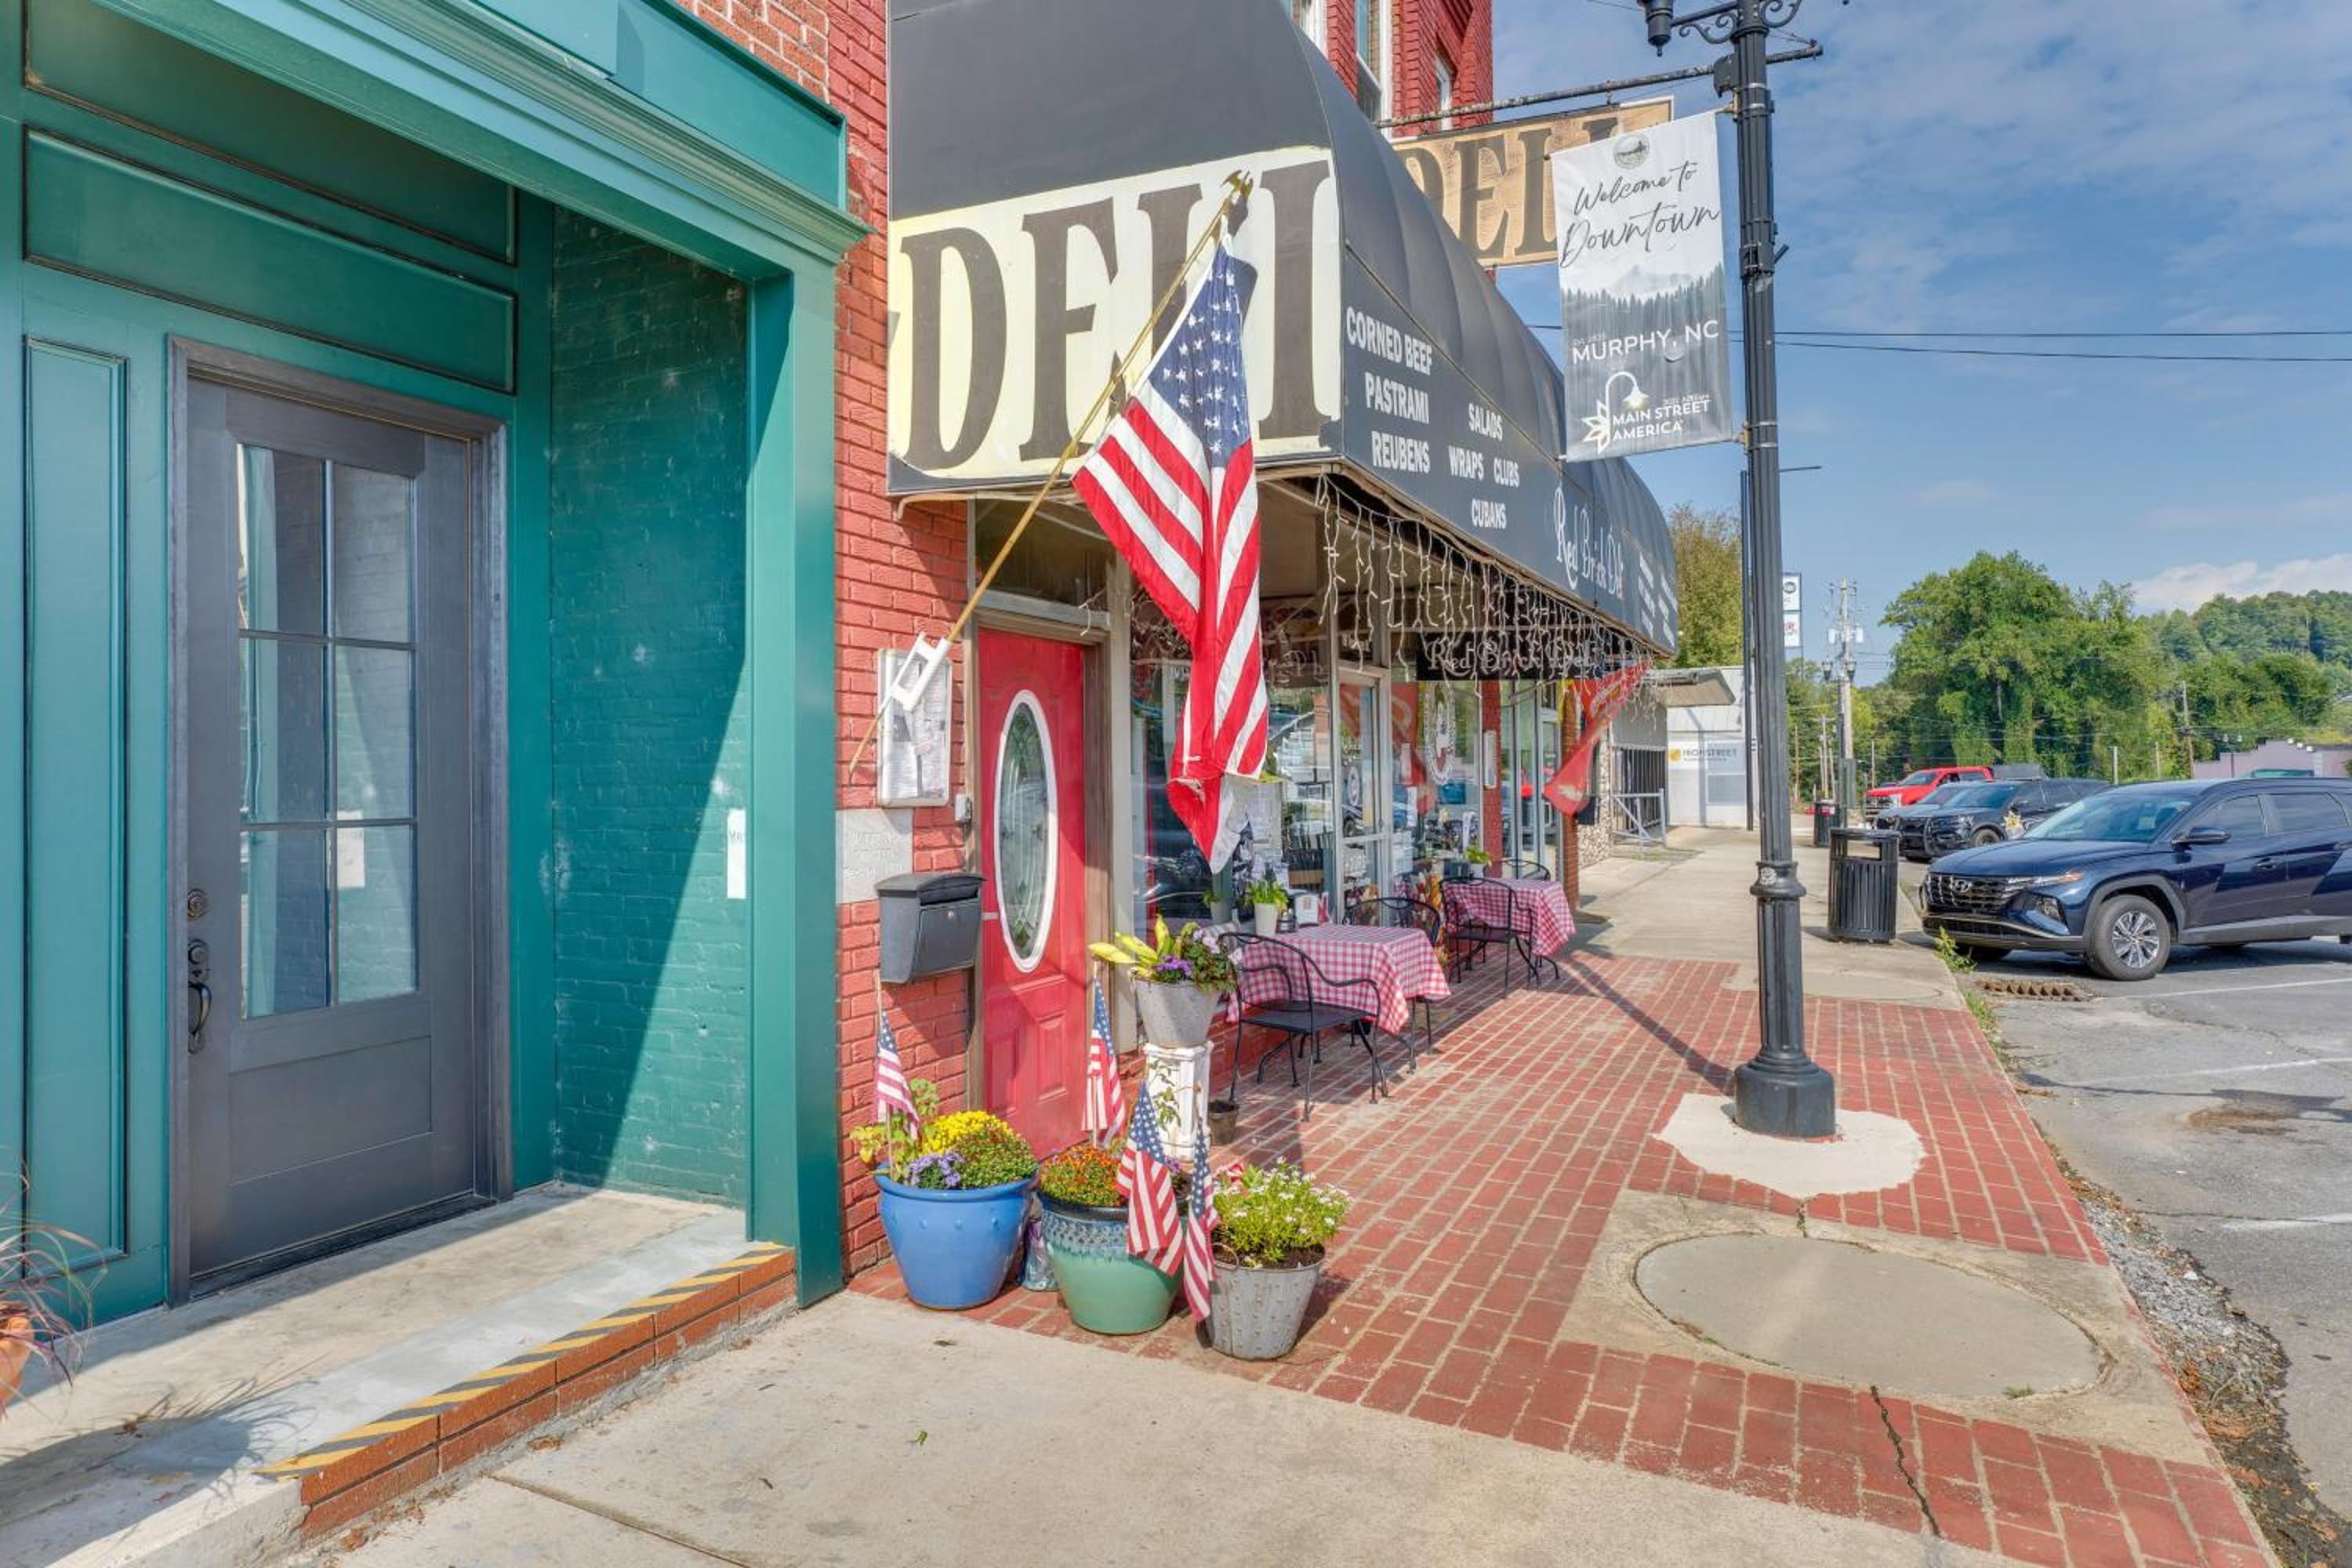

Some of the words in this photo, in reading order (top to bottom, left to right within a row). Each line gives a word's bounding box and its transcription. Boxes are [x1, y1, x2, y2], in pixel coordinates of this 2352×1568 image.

[1393, 118, 1617, 260] EL
[1573, 176, 1671, 216] Welcome
[1669, 160, 1697, 191] to
[1560, 201, 1720, 268] Downtown
[1346, 307, 1401, 364] CORNED
[1404, 334, 1433, 376] BEEF
[1572, 328, 1677, 365] MURPHY,
[1685, 320, 1719, 343] NC
[1364, 372, 1430, 424] PASTRAMI
[1613, 408, 1651, 426] MAIN
[1655, 399, 1711, 419] STREET
[1468, 403, 1503, 441] SALADS
[1613, 420, 1682, 441] AMERICA
[1371, 430, 1430, 474] REUBENS
[1449, 445, 1484, 481] WRAPS
[1494, 457, 1519, 488] CLUBS
[1472, 499, 1506, 530] CUBANS
